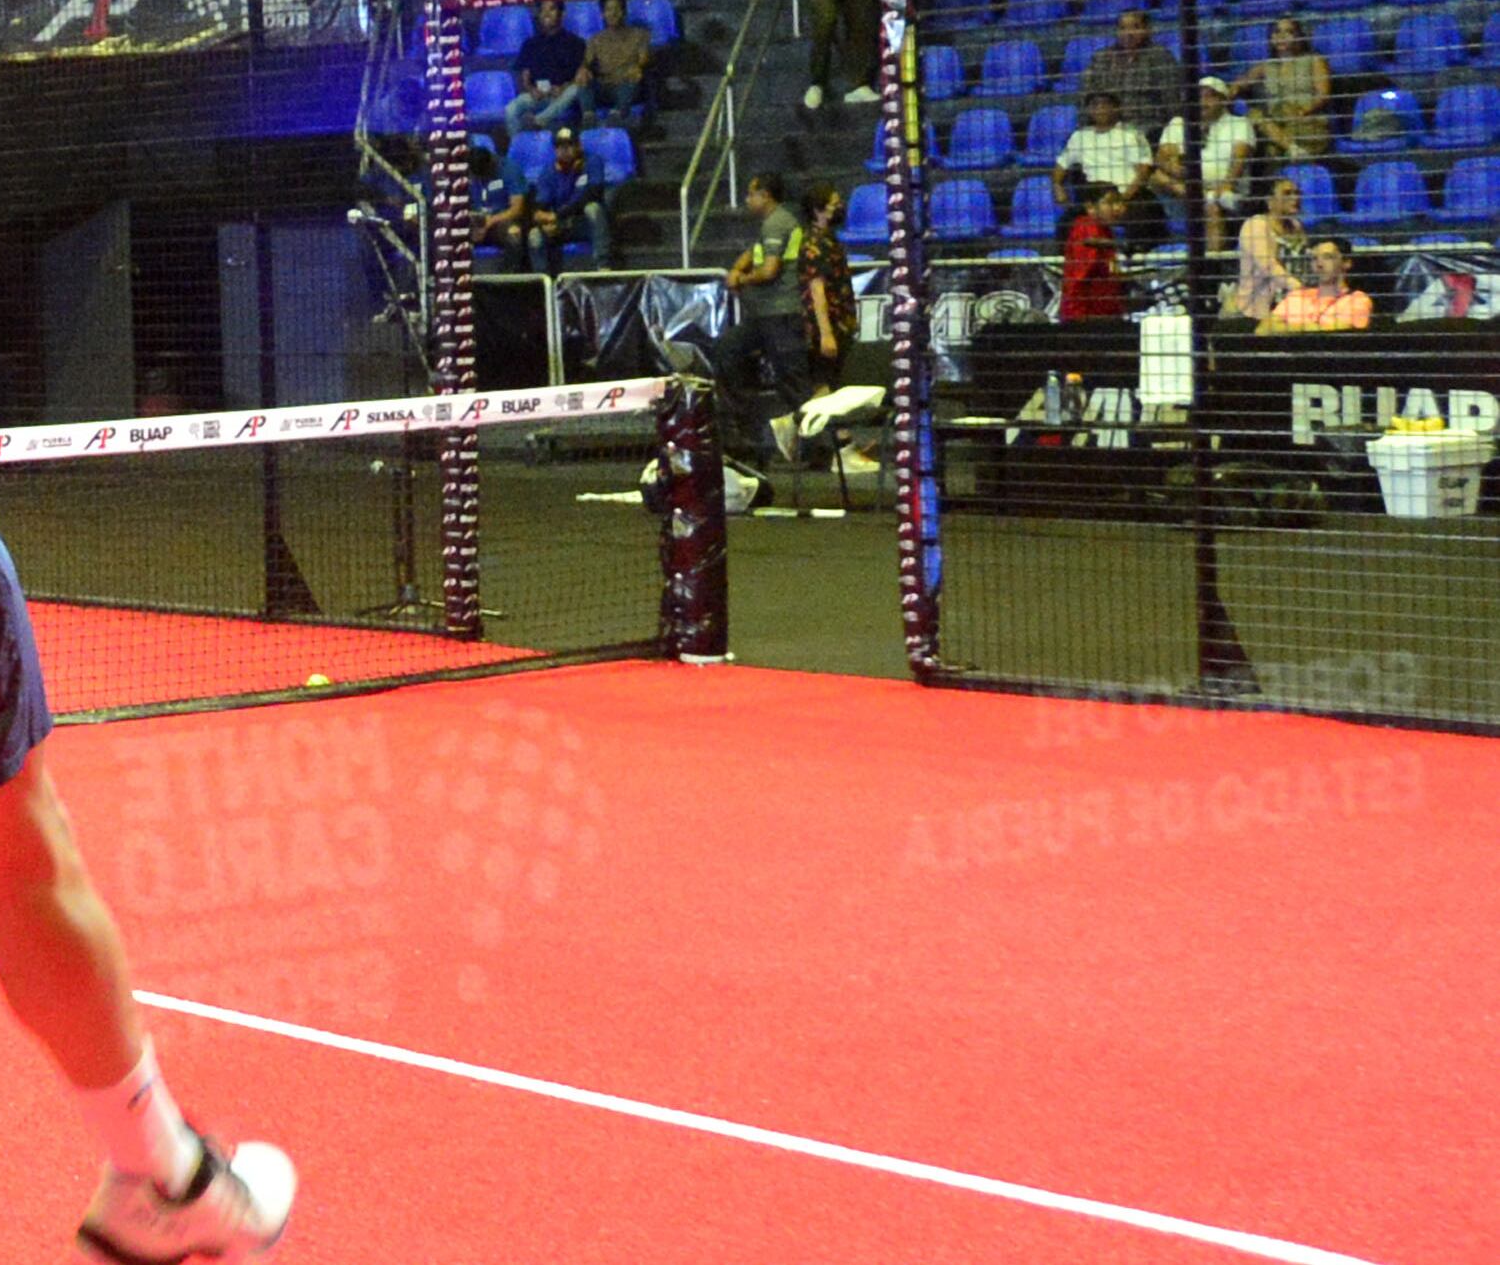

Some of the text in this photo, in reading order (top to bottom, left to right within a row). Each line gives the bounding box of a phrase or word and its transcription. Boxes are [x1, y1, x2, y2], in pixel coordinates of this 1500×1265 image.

[129, 426, 173, 443] BUAP
[367, 409, 415, 424] SIMSA
[501, 397, 541, 414] BUAP
